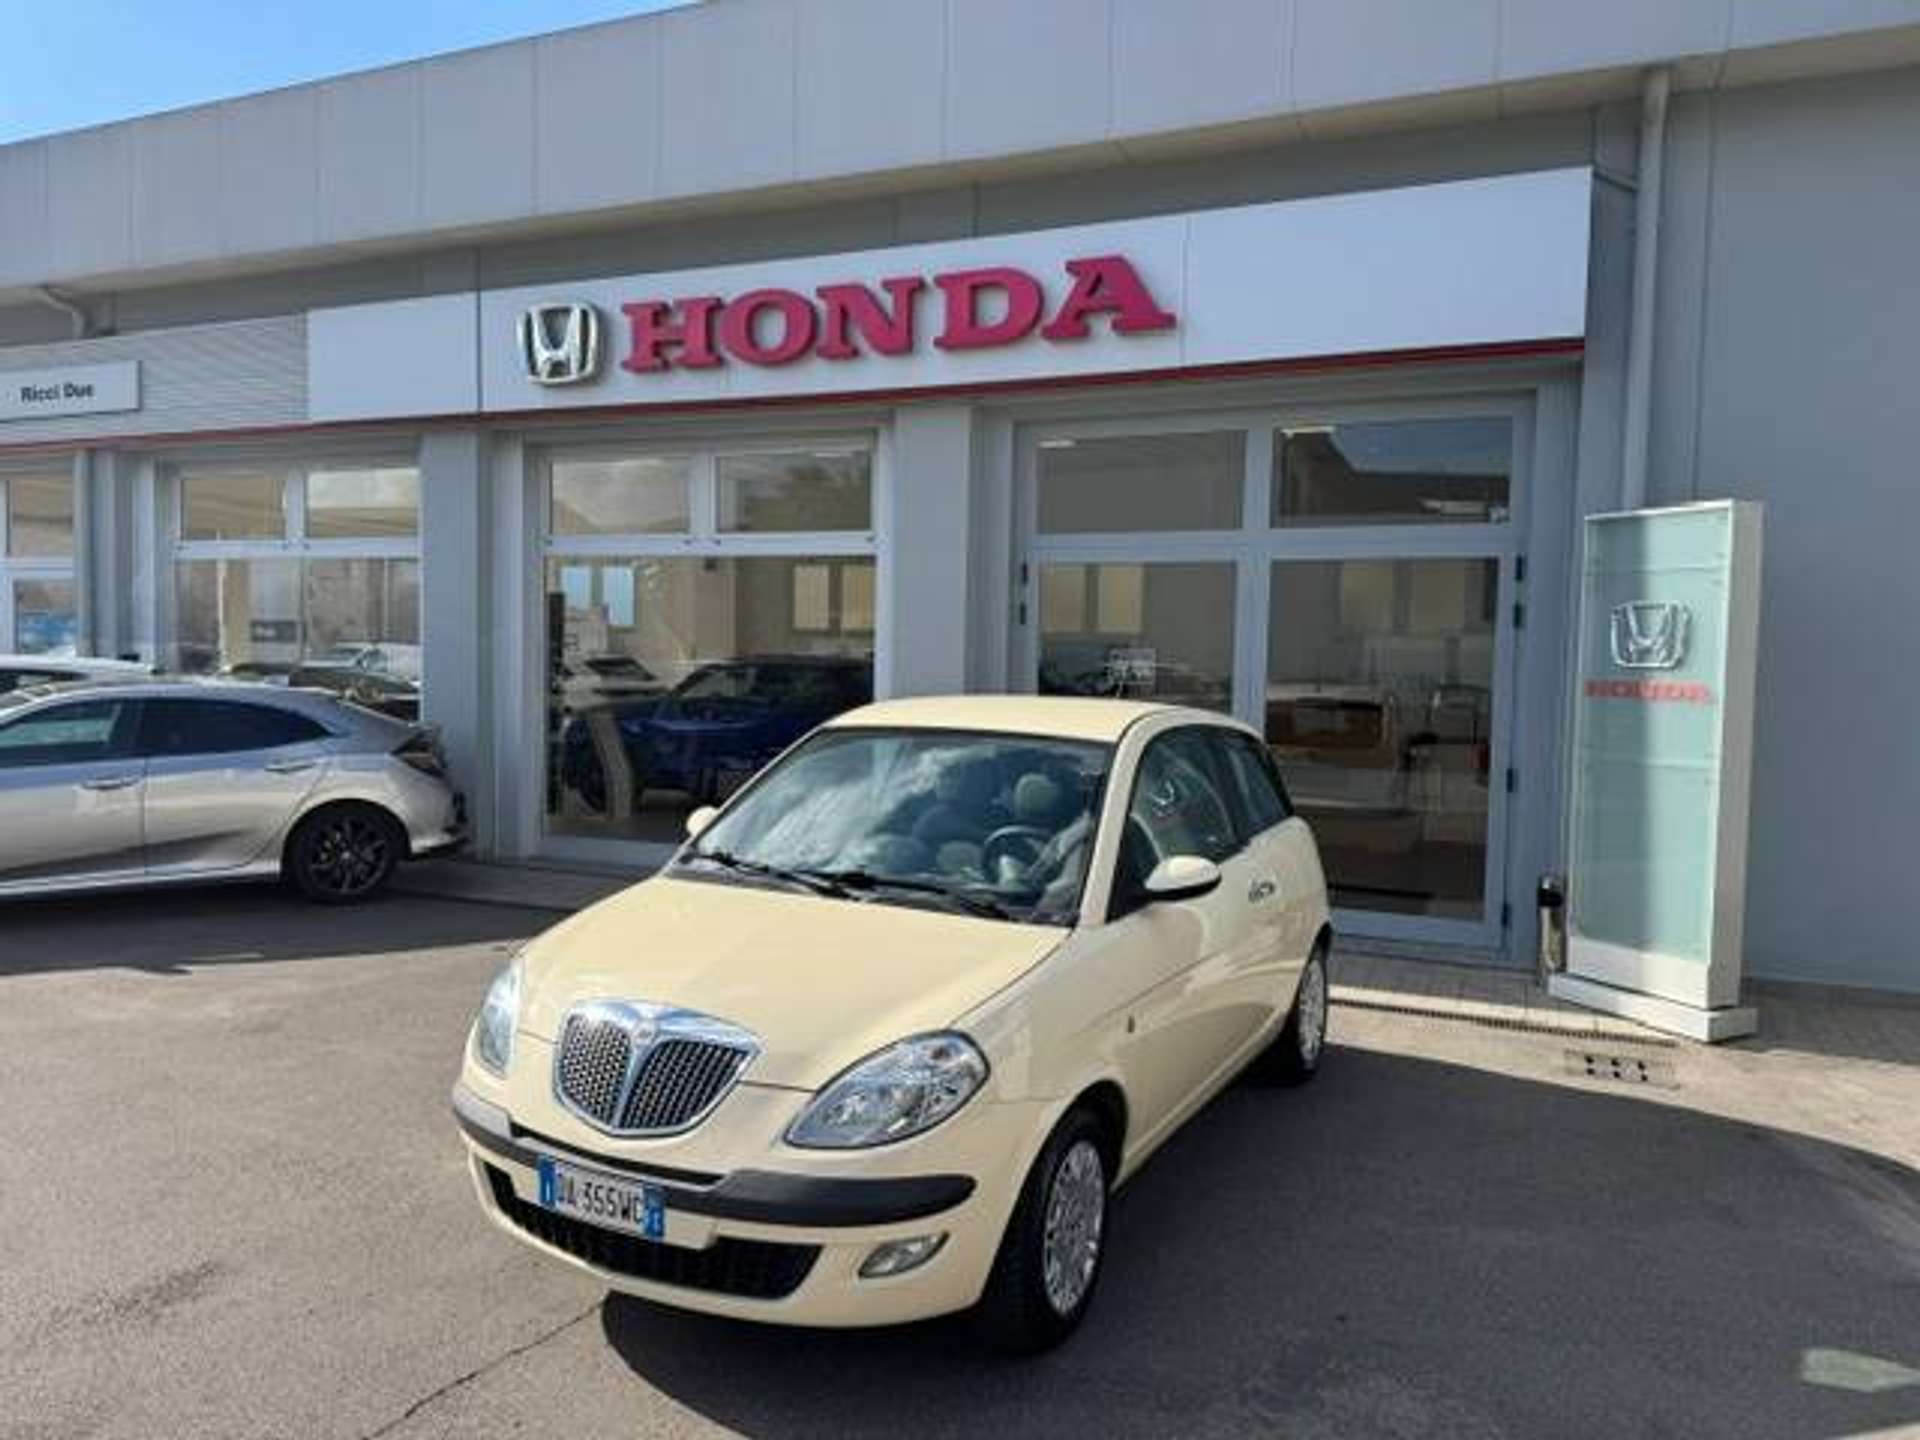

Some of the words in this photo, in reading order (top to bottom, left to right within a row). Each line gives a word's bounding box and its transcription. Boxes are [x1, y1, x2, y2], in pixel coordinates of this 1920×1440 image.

[620, 254, 1177, 373] HONDA
[20, 384, 60, 402] Ricci
[63, 381, 95, 398] Due
